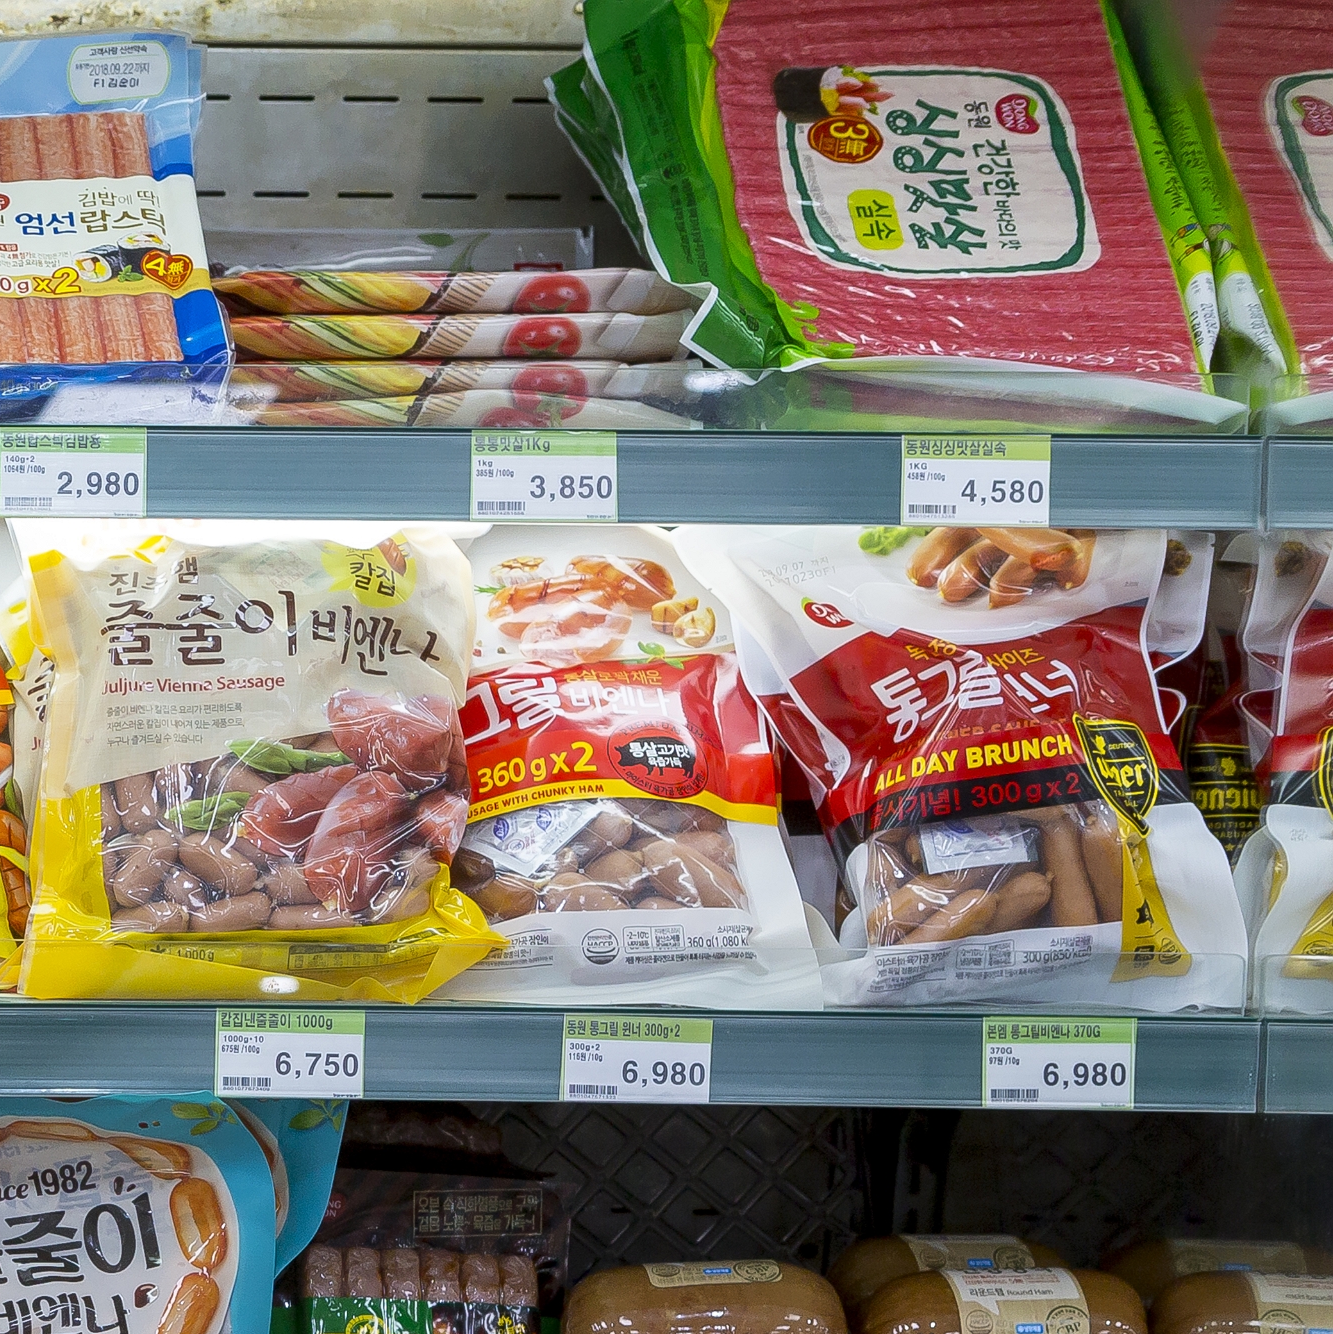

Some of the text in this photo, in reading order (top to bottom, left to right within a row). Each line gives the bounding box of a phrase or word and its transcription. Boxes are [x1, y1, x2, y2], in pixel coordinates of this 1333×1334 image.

[16, 206, 166, 237] 엄선 랍스틱
[58, 472, 138, 498] 2,980
[530, 476, 612, 501] 3,850
[962, 480, 1043, 505] 4,580
[348, 559, 397, 598] 칼집
[102, 591, 440, 676] 줄줄이 비엔나
[157, 672, 286, 693] Vienna Sausage
[872, 734, 1074, 795] ALL DAY BRUNCH
[220, 1012, 332, 1030] 칼집낸줄줄이 1000g
[1011, 1024, 1070, 1039] 통그릴비엔나
[1074, 1025, 1103, 1041] 370G
[990, 1047, 1012, 1055] 370G
[276, 1052, 358, 1079] 6,750
[623, 1061, 705, 1087] 6,980
[1044, 1063, 1126, 1089] 6,980
[32, 1163, 98, 1197] 1982
